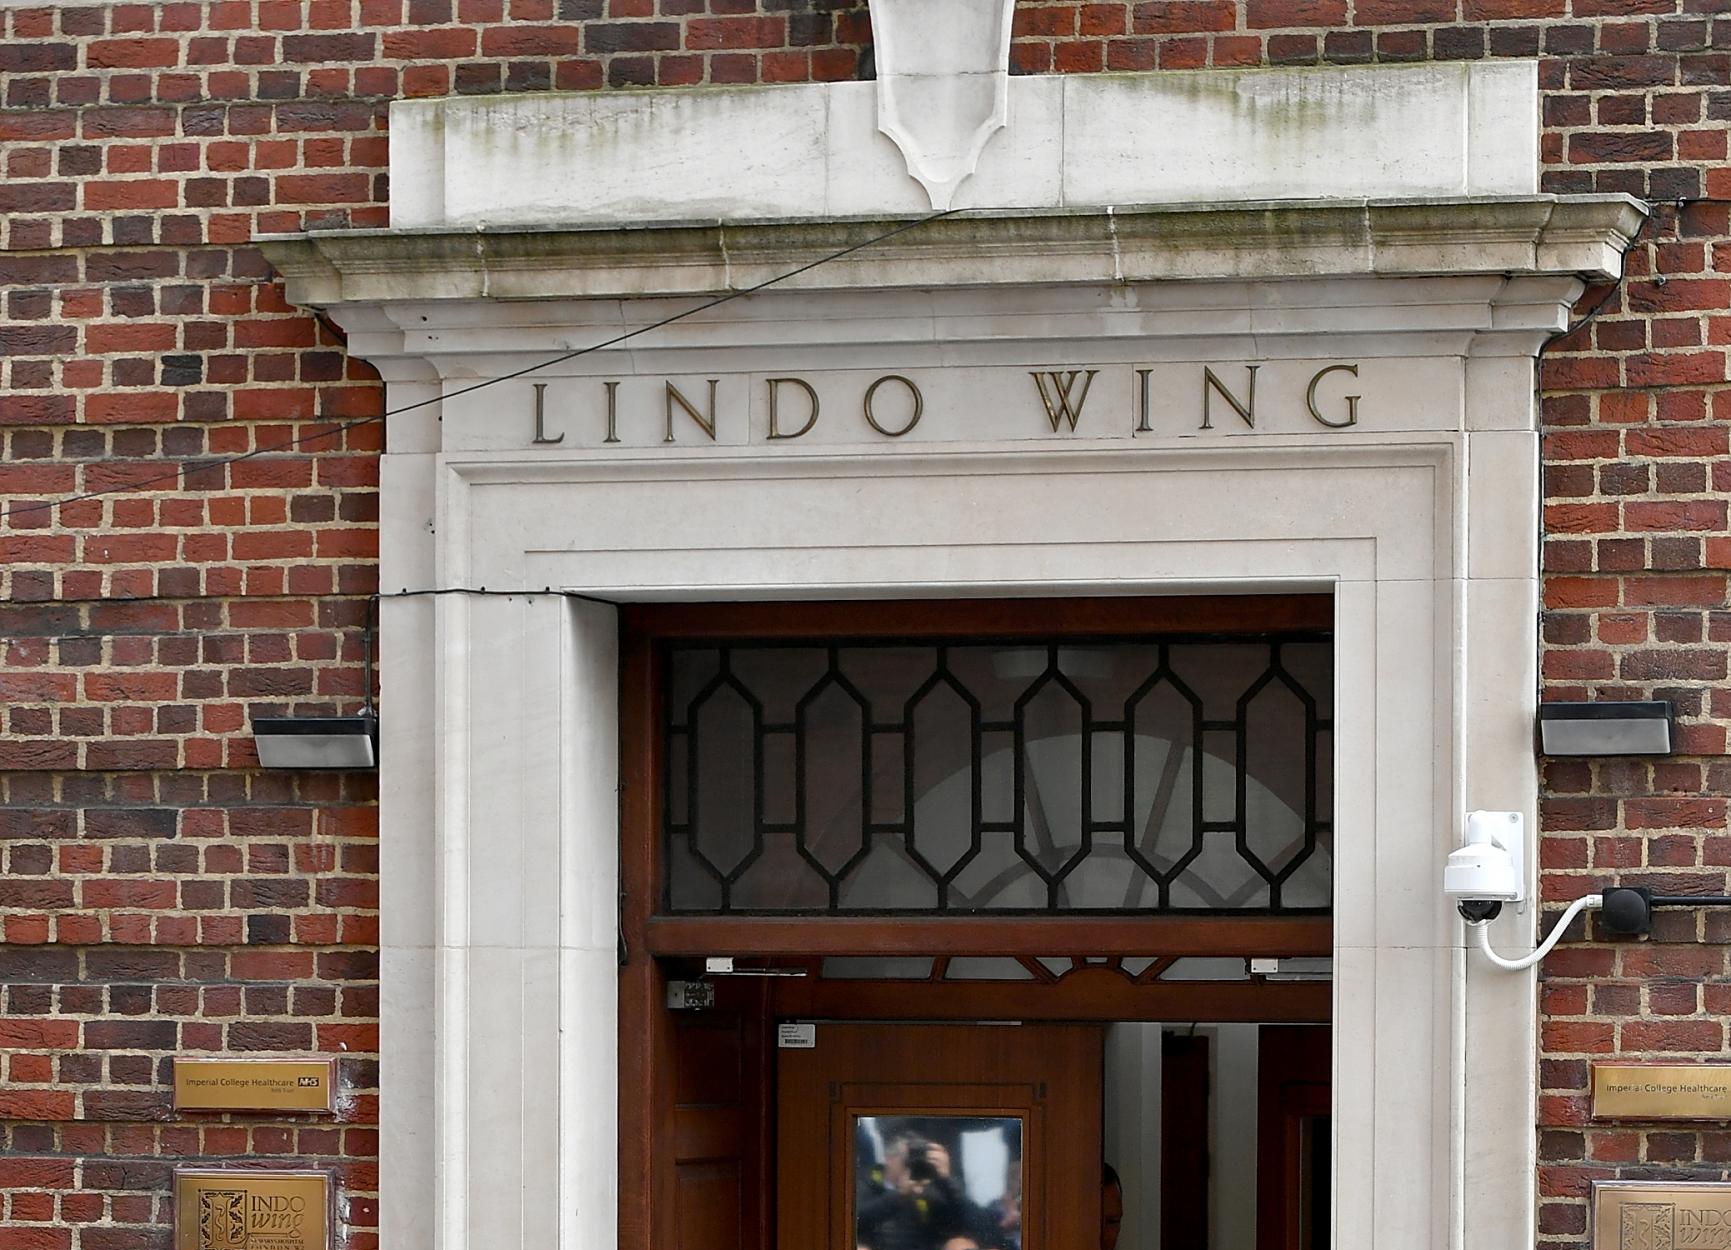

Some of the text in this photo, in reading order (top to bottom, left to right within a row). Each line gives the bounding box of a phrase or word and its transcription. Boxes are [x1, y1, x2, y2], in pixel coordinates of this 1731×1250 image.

[531, 363, 1361, 444] LINDO WING
[186, 1077, 319, 1088] Imperial College Healthcare NHS
[1644, 1084, 1678, 1094] College
[1680, 1084, 1728, 1093] Healthcare
